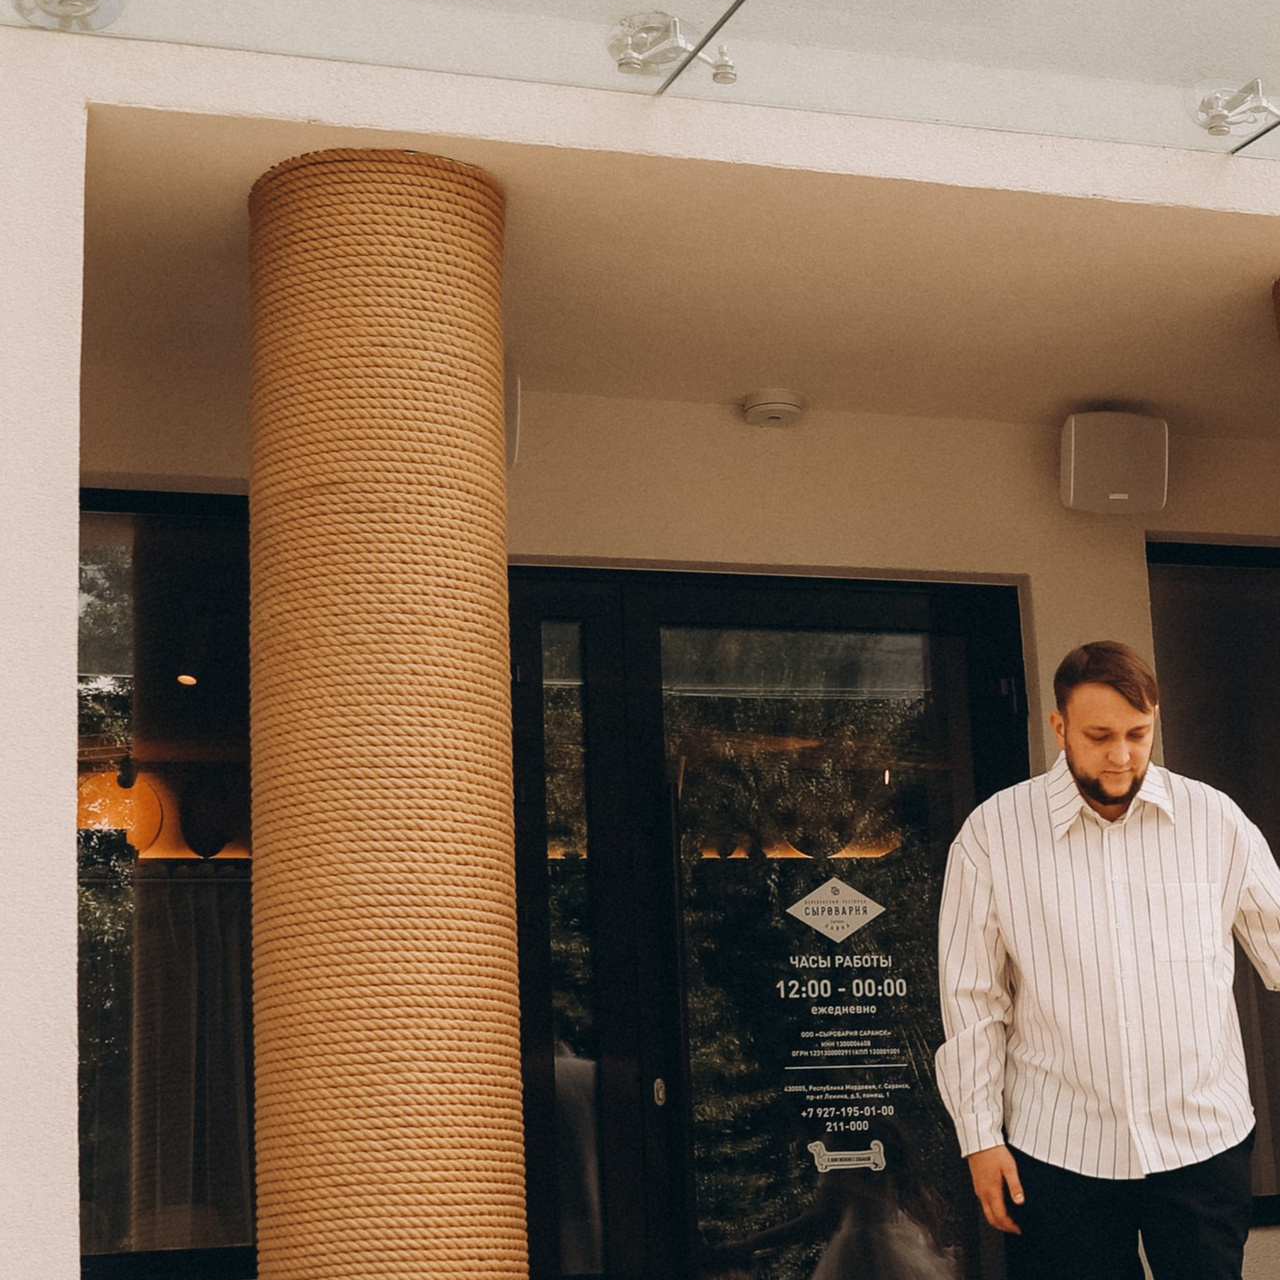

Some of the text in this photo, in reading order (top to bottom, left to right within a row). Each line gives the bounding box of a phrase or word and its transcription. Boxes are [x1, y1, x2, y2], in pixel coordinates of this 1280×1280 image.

[804, 906, 868, 916] СЫРОВАРНЯ
[790, 955, 892, 968] ЧАСЫ РАБОТЫ
[776, 979, 832, 999] 12:00
[852, 979, 907, 997] 00:00
[811, 1005, 877, 1016] ежедневно
[801, 1105, 894, 1118] +7 927-195-01-00
[826, 1120, 869, 1132] 211-000
